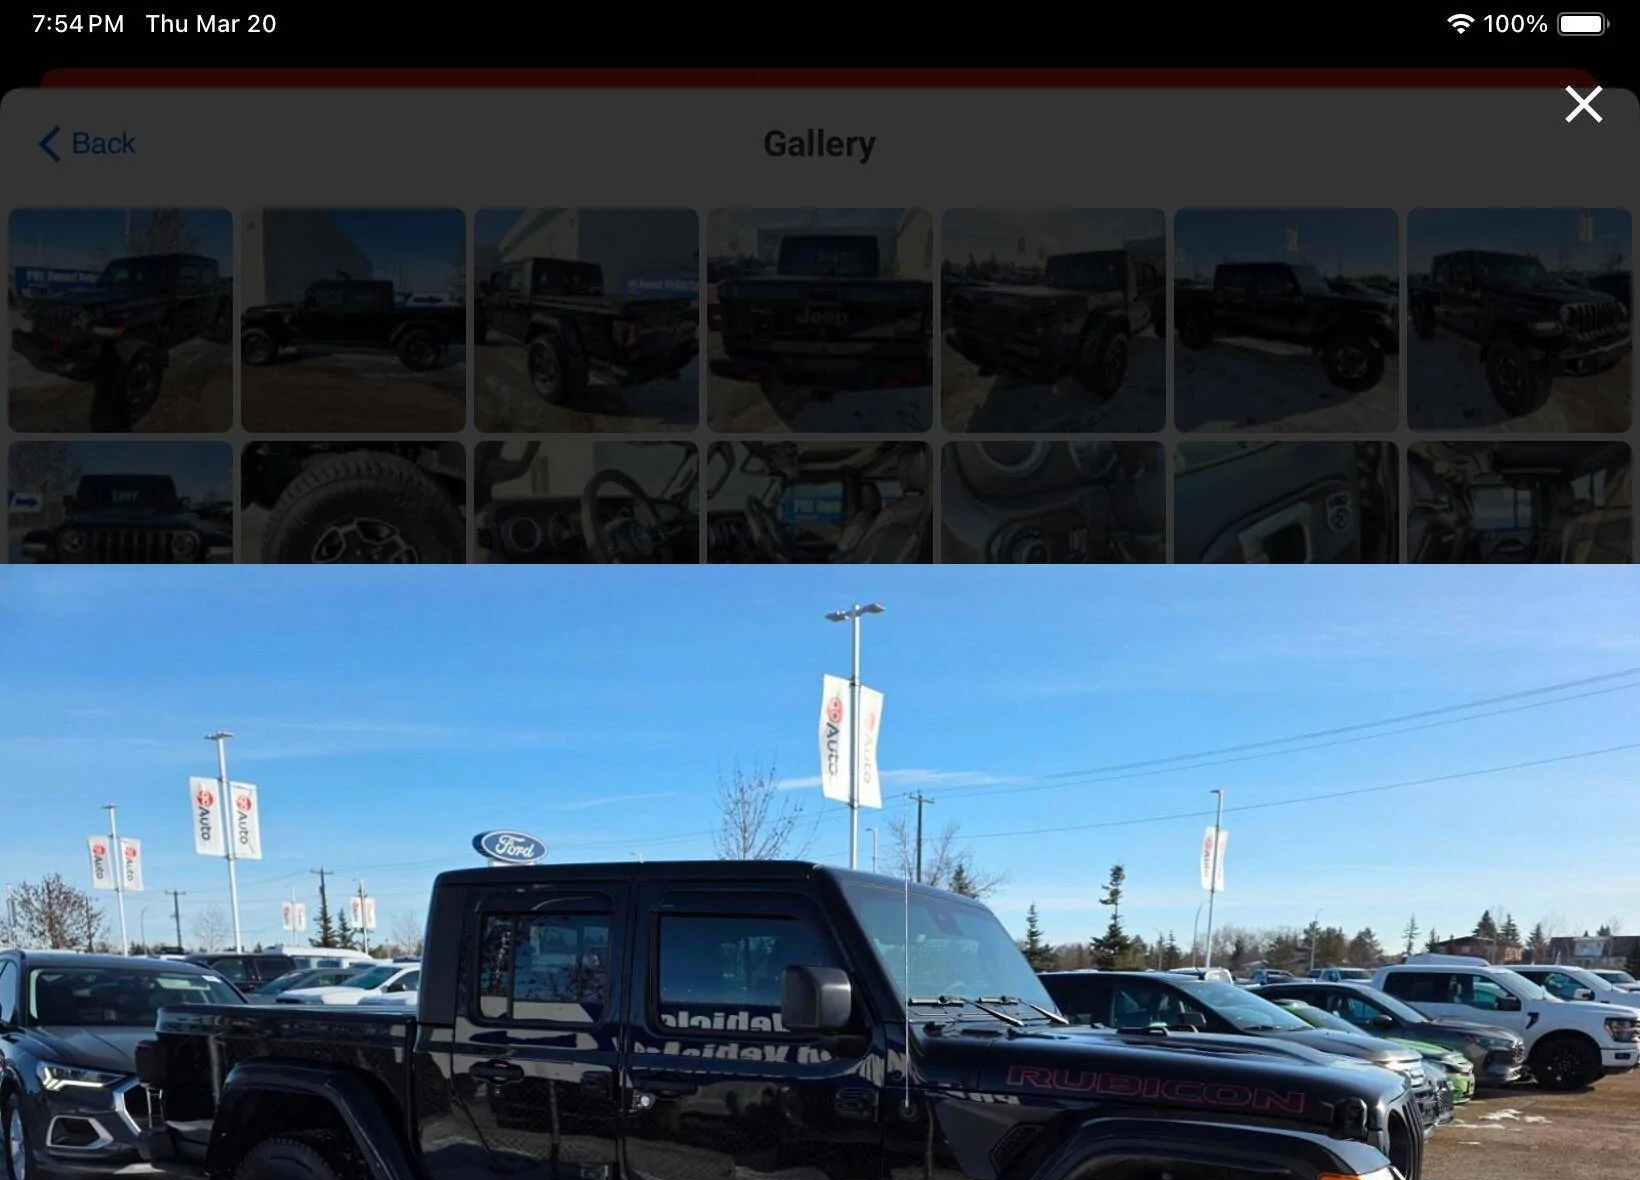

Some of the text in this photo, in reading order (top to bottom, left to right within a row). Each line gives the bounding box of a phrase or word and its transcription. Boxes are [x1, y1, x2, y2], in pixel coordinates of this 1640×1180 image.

[33, 15, 123, 32] 7:54 PM
[146, 14, 276, 32] Thu Mar 20
[1484, 15, 1547, 32] 100%
[74, 132, 135, 154] Back
[765, 129, 876, 164] Gallery
[826, 722, 839, 776] Auto
[199, 806, 211, 841] Auto
[237, 811, 249, 845] Auto
[495, 834, 535, 858] Ford
[94, 855, 104, 880] Auto
[126, 858, 135, 882] Auto
[1006, 1065, 1306, 1114] RUBICON
